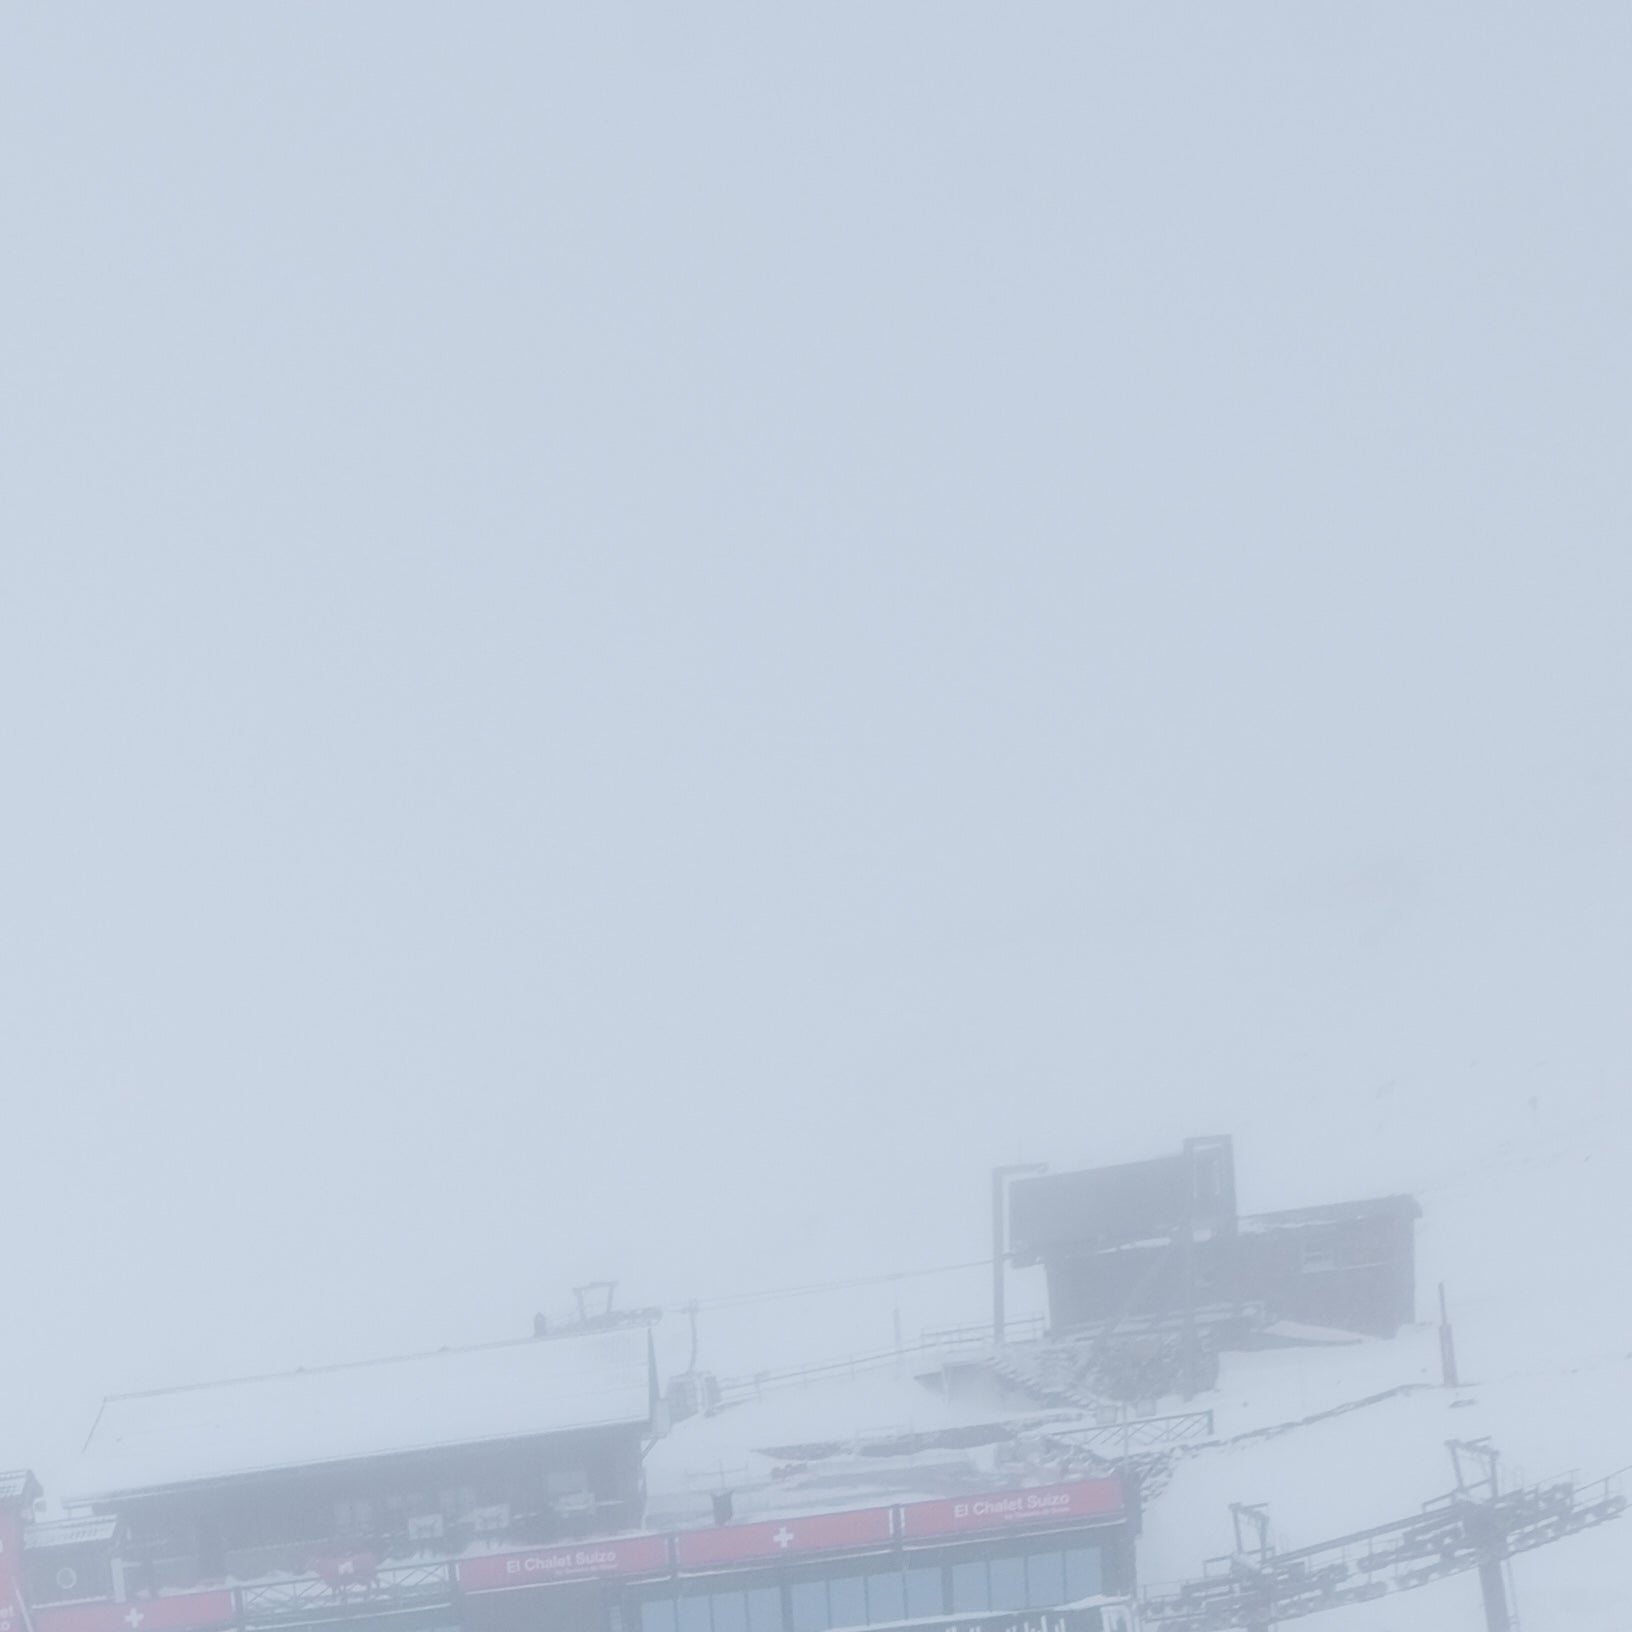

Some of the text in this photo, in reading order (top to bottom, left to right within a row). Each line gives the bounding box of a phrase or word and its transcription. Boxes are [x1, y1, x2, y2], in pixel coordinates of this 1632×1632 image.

[955, 1504, 969, 1518] El
[973, 1498, 1023, 1516] Chalet
[1027, 1494, 1070, 1509] Suizo
[507, 1560, 520, 1573] El
[524, 1554, 572, 1571] Chalet
[576, 1551, 616, 1565] Suizo
